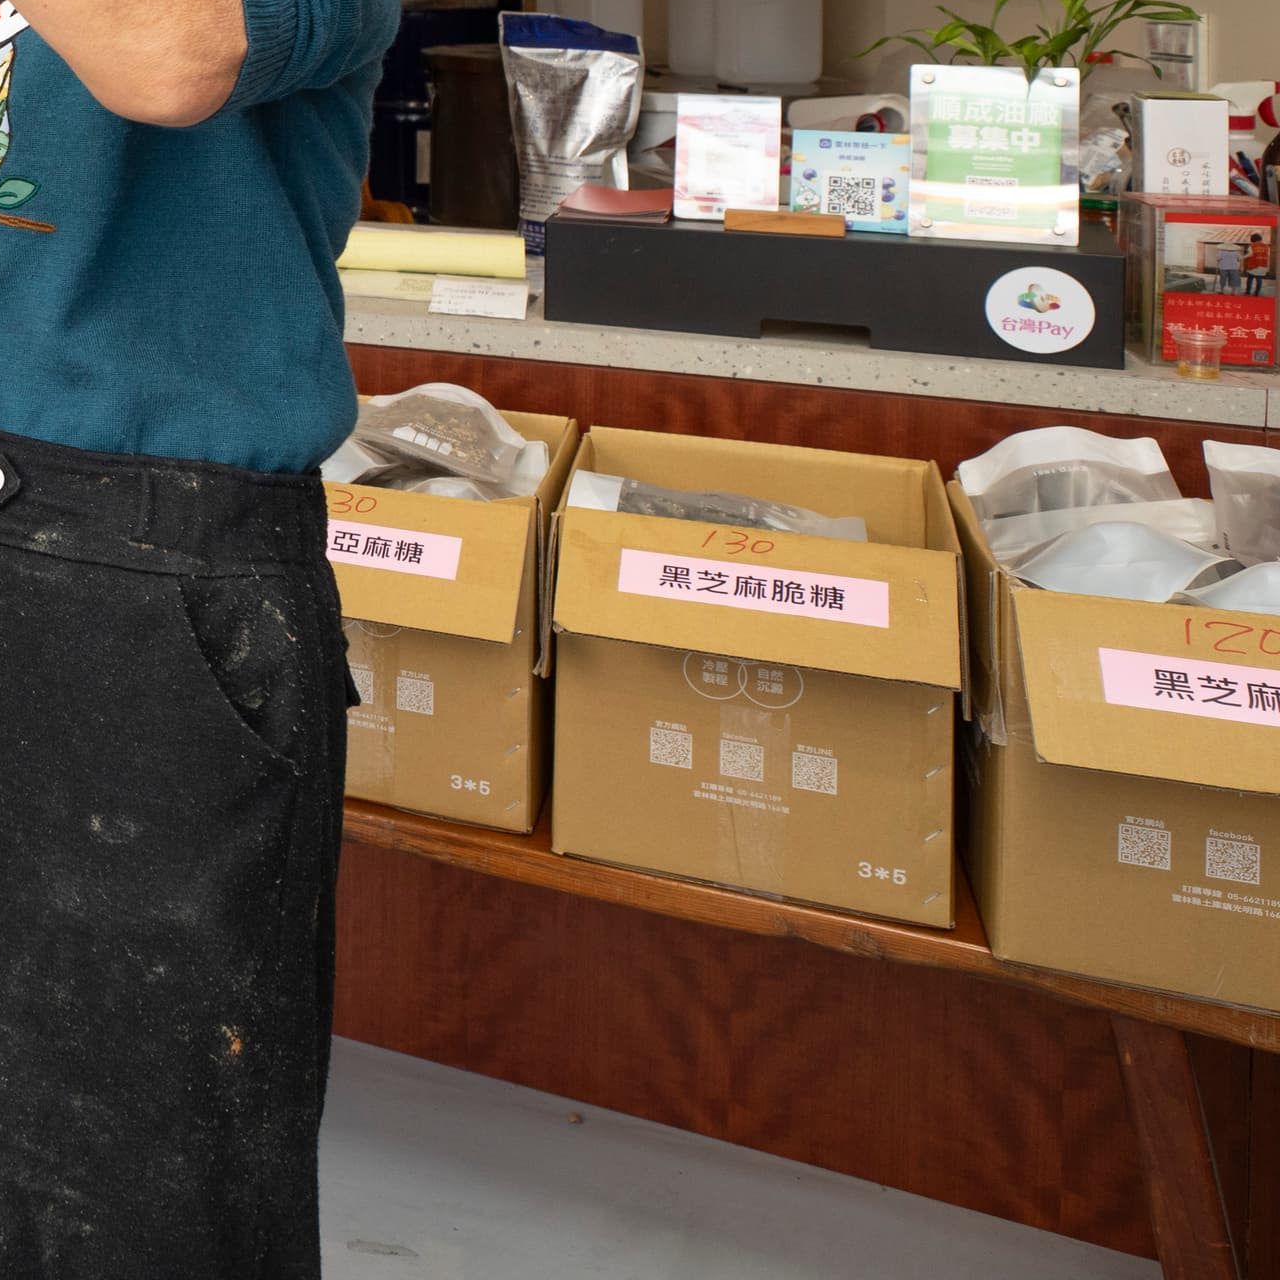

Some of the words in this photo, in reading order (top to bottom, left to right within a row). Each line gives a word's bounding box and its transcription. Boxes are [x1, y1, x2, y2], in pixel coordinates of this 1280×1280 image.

[1001, 317, 1074, 340] 台灣Pay
[330, 530, 425, 564] 亞麻糖
[701, 530, 775, 555] 130
[658, 564, 845, 611] 黑芝麻脆糖
[1153, 668, 1280, 712] 黑芝麻
[1209, 828, 1255, 842] facebook
